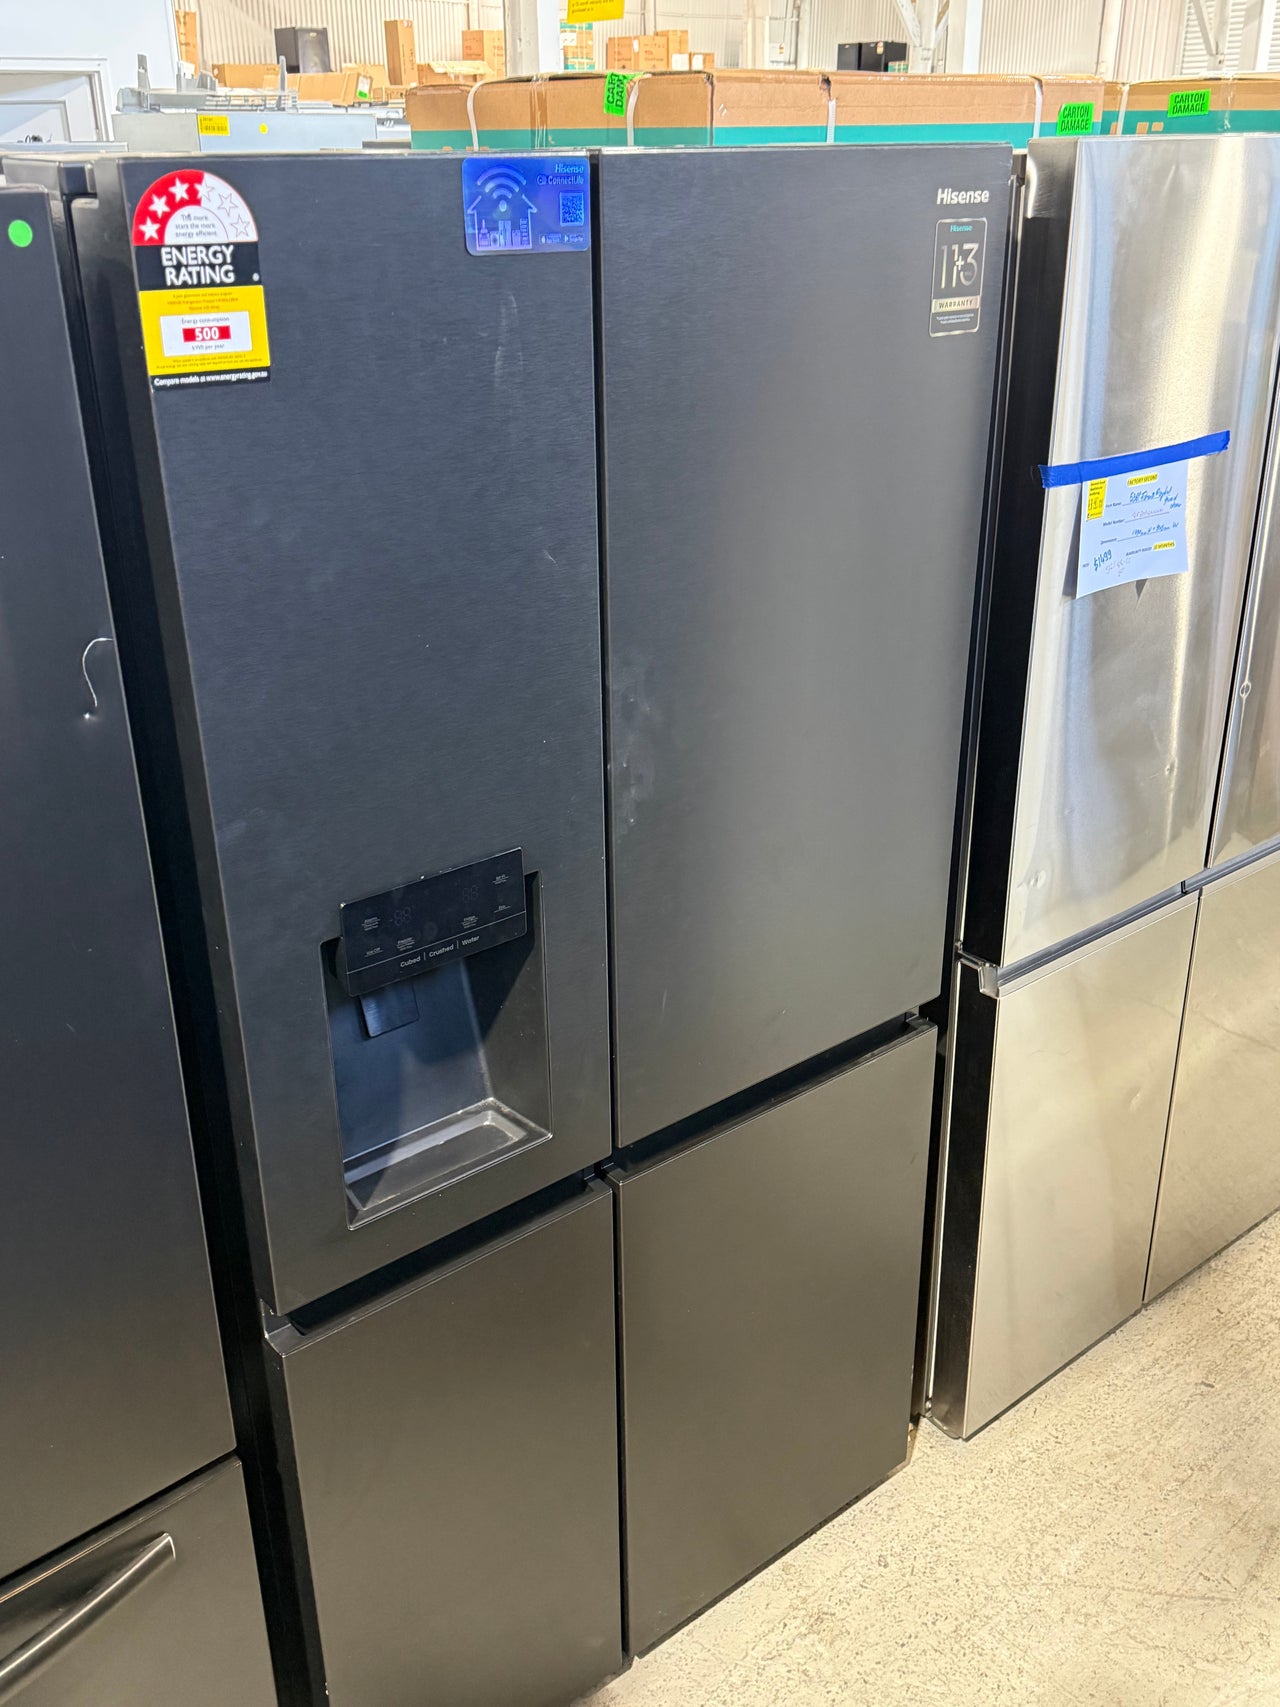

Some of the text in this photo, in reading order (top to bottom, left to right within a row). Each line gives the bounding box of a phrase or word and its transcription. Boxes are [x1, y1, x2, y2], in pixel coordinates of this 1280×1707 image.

[1174, 93, 1205, 104] CARTON
[1062, 105, 1089, 119] CARTON
[1172, 103, 1205, 114] DAMAGE
[1060, 119, 1089, 132] DAMAGE
[936, 188, 990, 205] Hisense
[161, 244, 234, 267] ENERGY
[165, 264, 236, 287] RATING
[938, 299, 973, 309] WARRANTY
[194, 326, 220, 341] 500
[154, 377, 180, 387] Compare
[180, 374, 200, 384] models
[400, 955, 421, 967] Cubed
[428, 943, 454, 957] Crushed
[462, 935, 480, 946] Water
